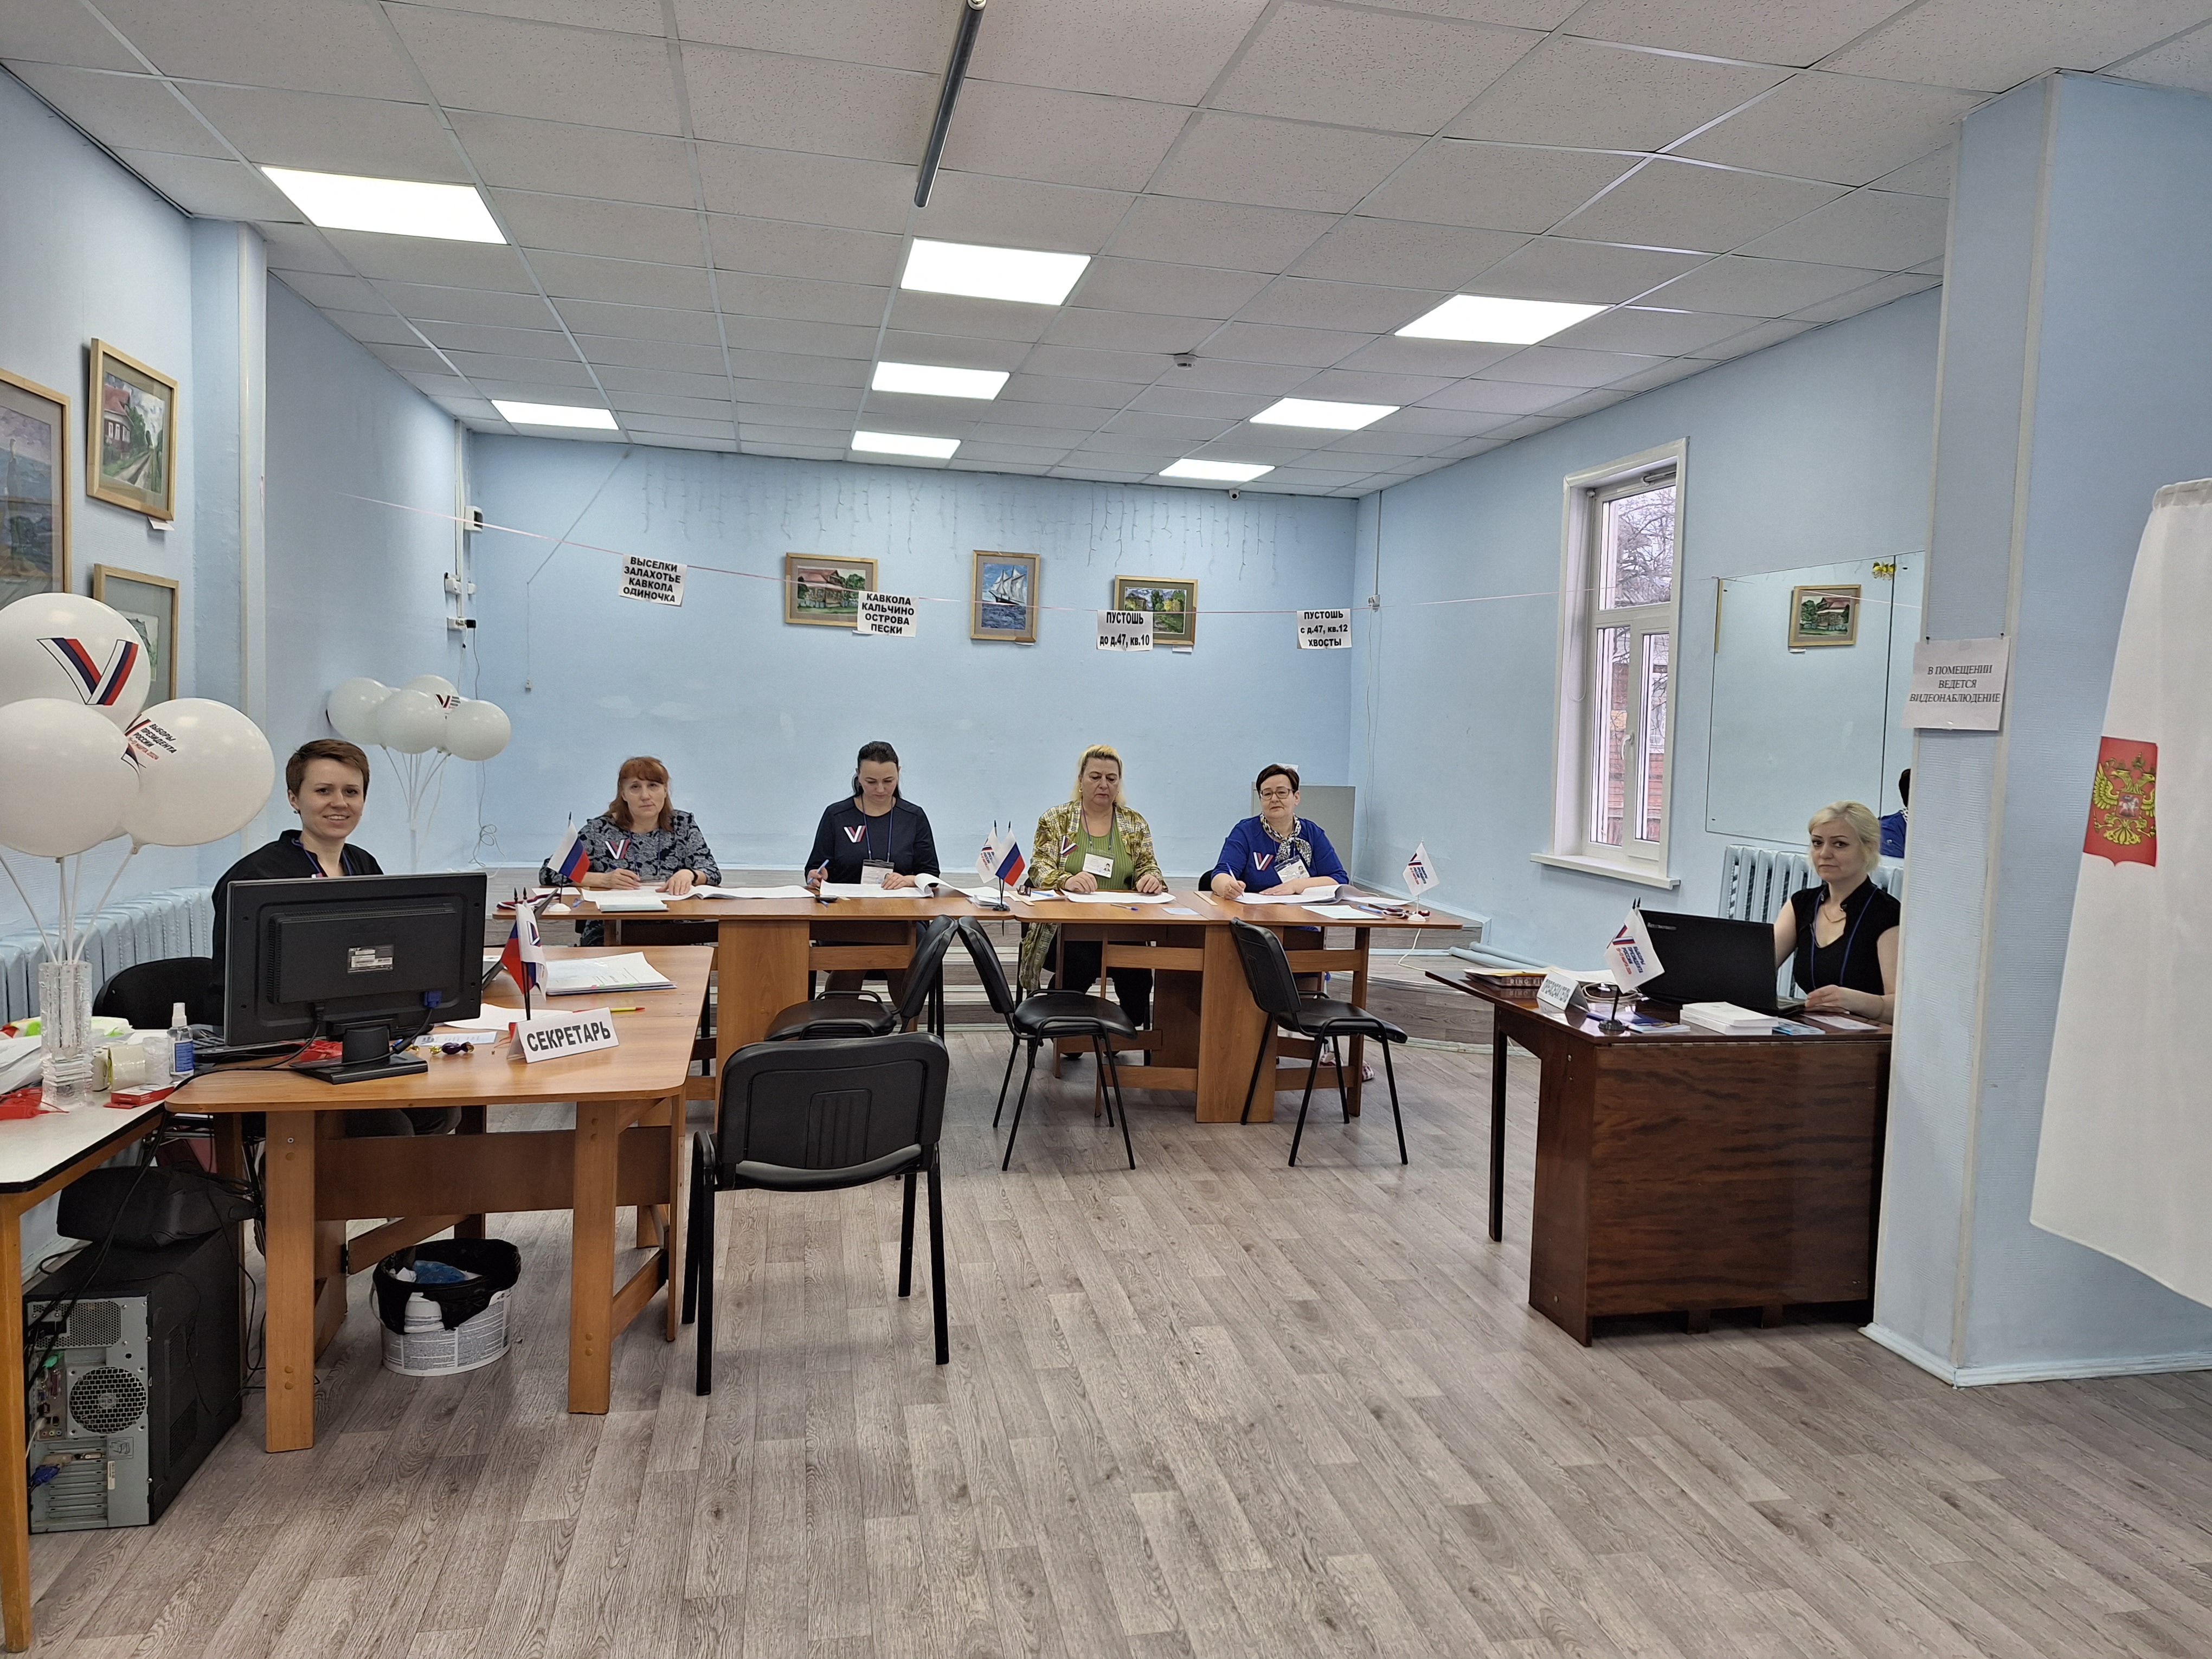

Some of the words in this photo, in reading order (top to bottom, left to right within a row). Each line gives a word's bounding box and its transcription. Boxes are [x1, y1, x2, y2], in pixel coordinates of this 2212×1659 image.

[630, 556, 678, 573] ВЫСЕЛКИ
[623, 566, 681, 584] ЗАЛАХОТЬЕ
[628, 577, 673, 593] КАВКОЛА
[623, 587, 675, 602] ОДИНОЧКА
[866, 593, 912, 606] КАВКОЛА
[861, 602, 915, 616] КАЛЬЧИНО
[1304, 610, 1343, 620] ПУСТОШЬ
[865, 613, 910, 626] ОСТРОВА
[1106, 612, 1144, 625] ПУСТОШЬ
[871, 623, 903, 634] ПЕСКИ
[1307, 625, 1326, 635] д.47,
[1327, 624, 1348, 633] кв.12
[1099, 635, 1109, 646] до
[1110, 633, 1128, 648] д.47,
[1130, 634, 1150, 646] кв.10
[1308, 638, 1342, 647] ХВОСТЫ
[1927, 666, 1933, 675] В
[1935, 665, 1993, 675] ПОМЕЩЕНИИ
[1938, 679, 1977, 689] ВЕДЕТСЯ
[1909, 693, 2001, 703] ВИДЕОНАБЛЮДЕНИЕ
[149, 723, 176, 741] ВЫБОРЫ
[133, 732, 155, 747] РОССИИ
[140, 728, 177, 754] ПРЕЗИДЕНТА
[526, 1021, 611, 1052] СЕКРЕТАРЬ
